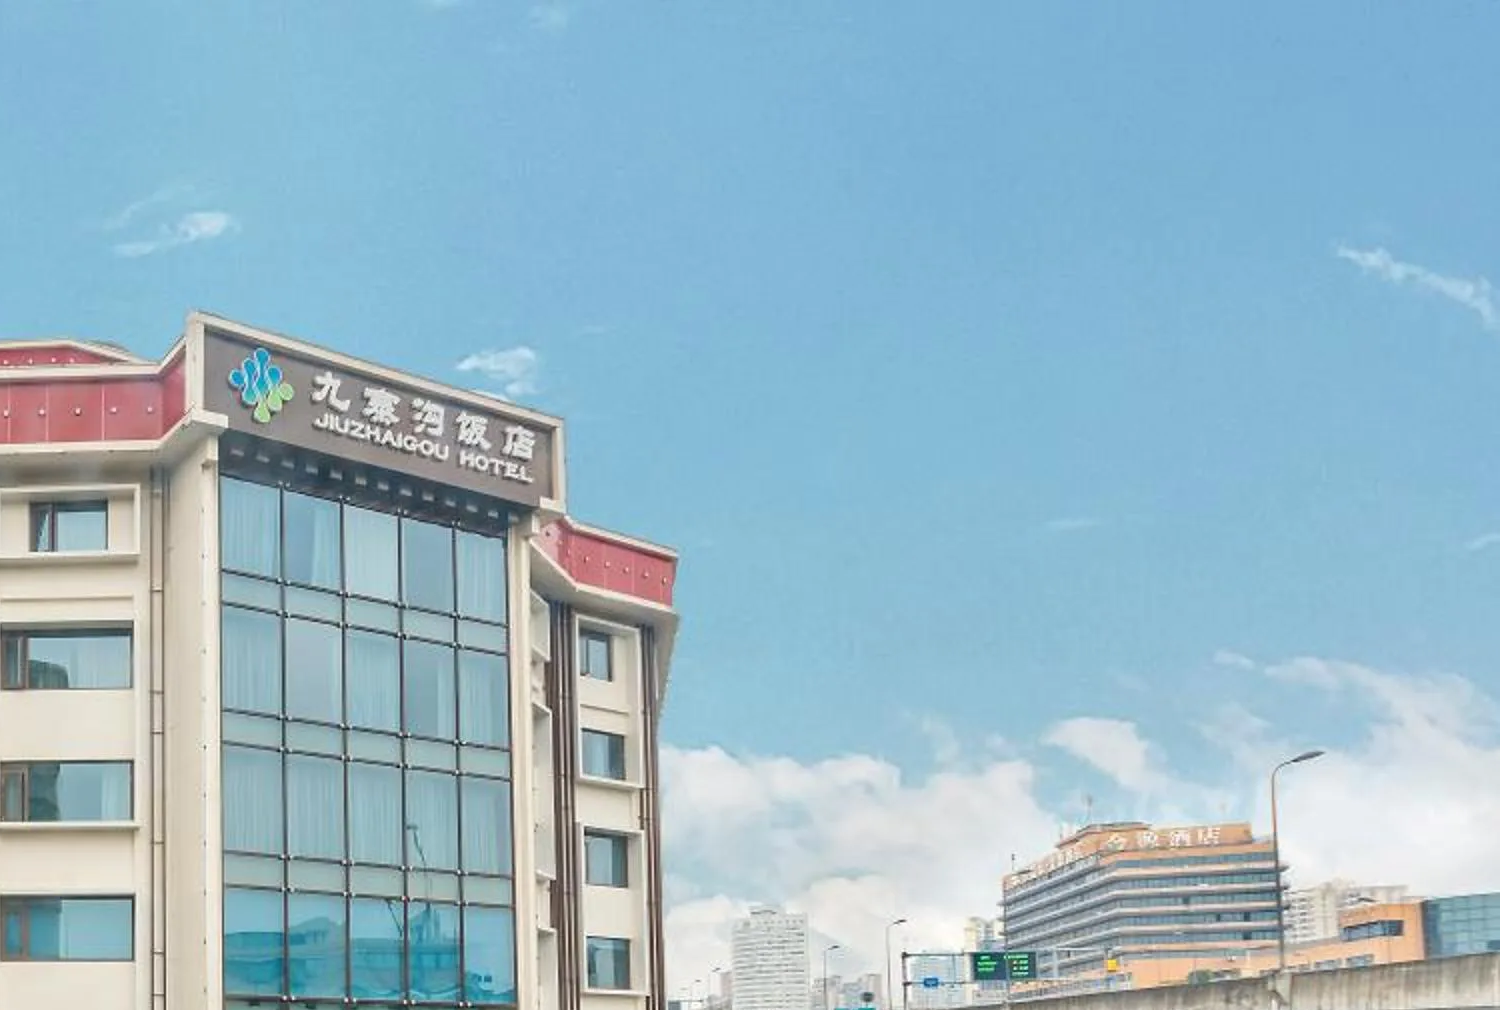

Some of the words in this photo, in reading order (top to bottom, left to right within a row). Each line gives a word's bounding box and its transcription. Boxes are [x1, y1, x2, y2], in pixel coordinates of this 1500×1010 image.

[311, 371, 537, 460] 九寨沟饭店
[313, 412, 450, 462] JIUZHAIGOU
[459, 452, 534, 484] HOTEL
